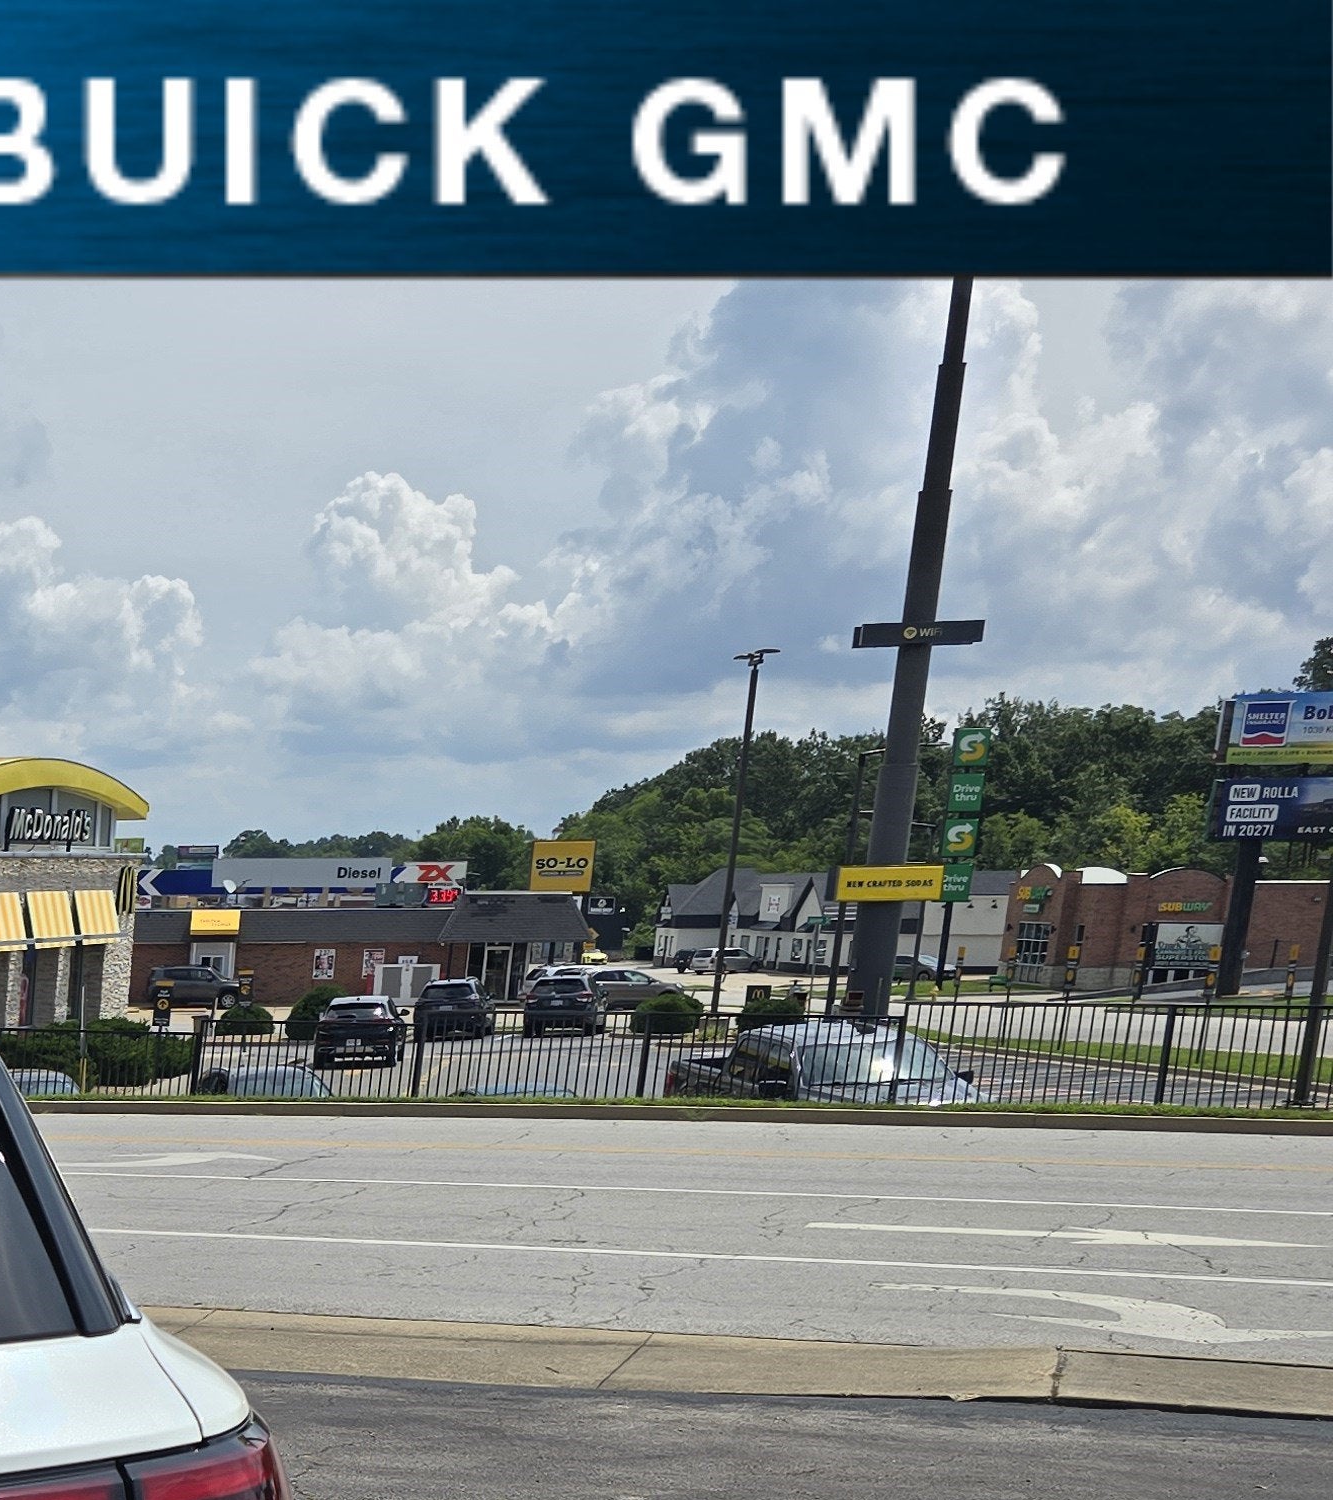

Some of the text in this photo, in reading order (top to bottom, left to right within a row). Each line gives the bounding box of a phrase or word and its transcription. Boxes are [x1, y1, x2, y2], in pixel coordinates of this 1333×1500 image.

[953, 785, 981, 793] Drive
[1233, 787, 1299, 799] NEW ROLLA
[955, 793, 978, 802] thru
[1230, 807, 1275, 819] FACILITY
[8, 807, 92, 841] McDonald's
[1222, 824, 1274, 837] IN 2027!
[536, 857, 589, 869] SO-LO
[337, 866, 382, 879] Diesel
[416, 864, 455, 882] ZX
[905, 879, 933, 887] SODAS
[943, 883, 965, 892] thru
[1159, 902, 1212, 912] SUBWAY
